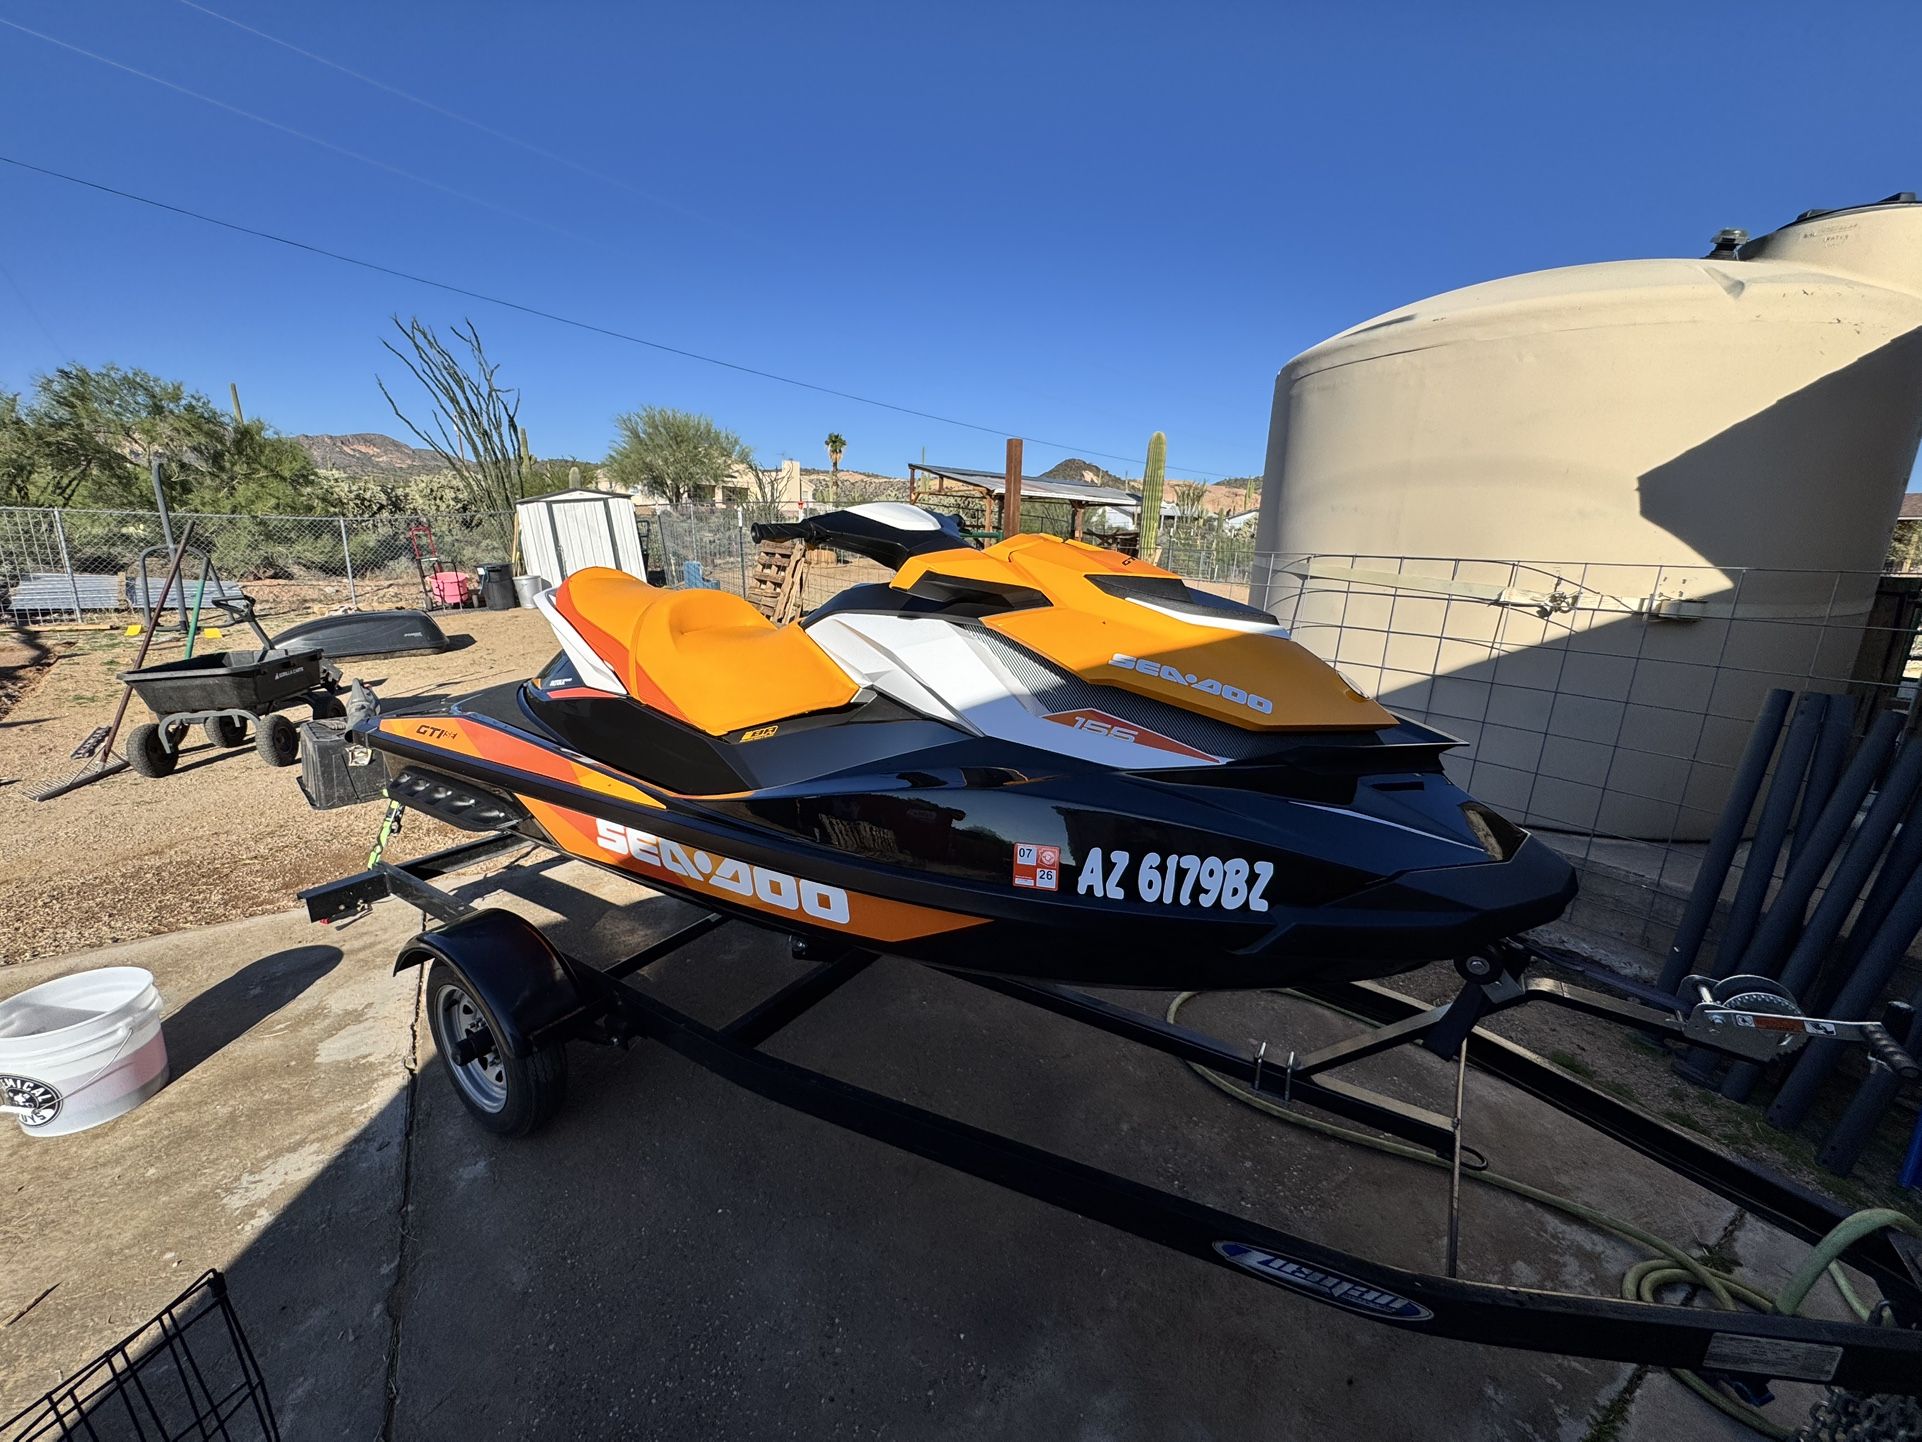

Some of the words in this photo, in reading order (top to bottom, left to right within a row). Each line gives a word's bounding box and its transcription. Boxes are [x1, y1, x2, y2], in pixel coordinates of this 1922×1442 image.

[1073, 716, 1139, 743] 155
[1018, 847, 1033, 859] 07
[1039, 869, 1053, 881] 26
[1077, 847, 1130, 900] AZ
[1138, 852, 1274, 912] 6179BZ
